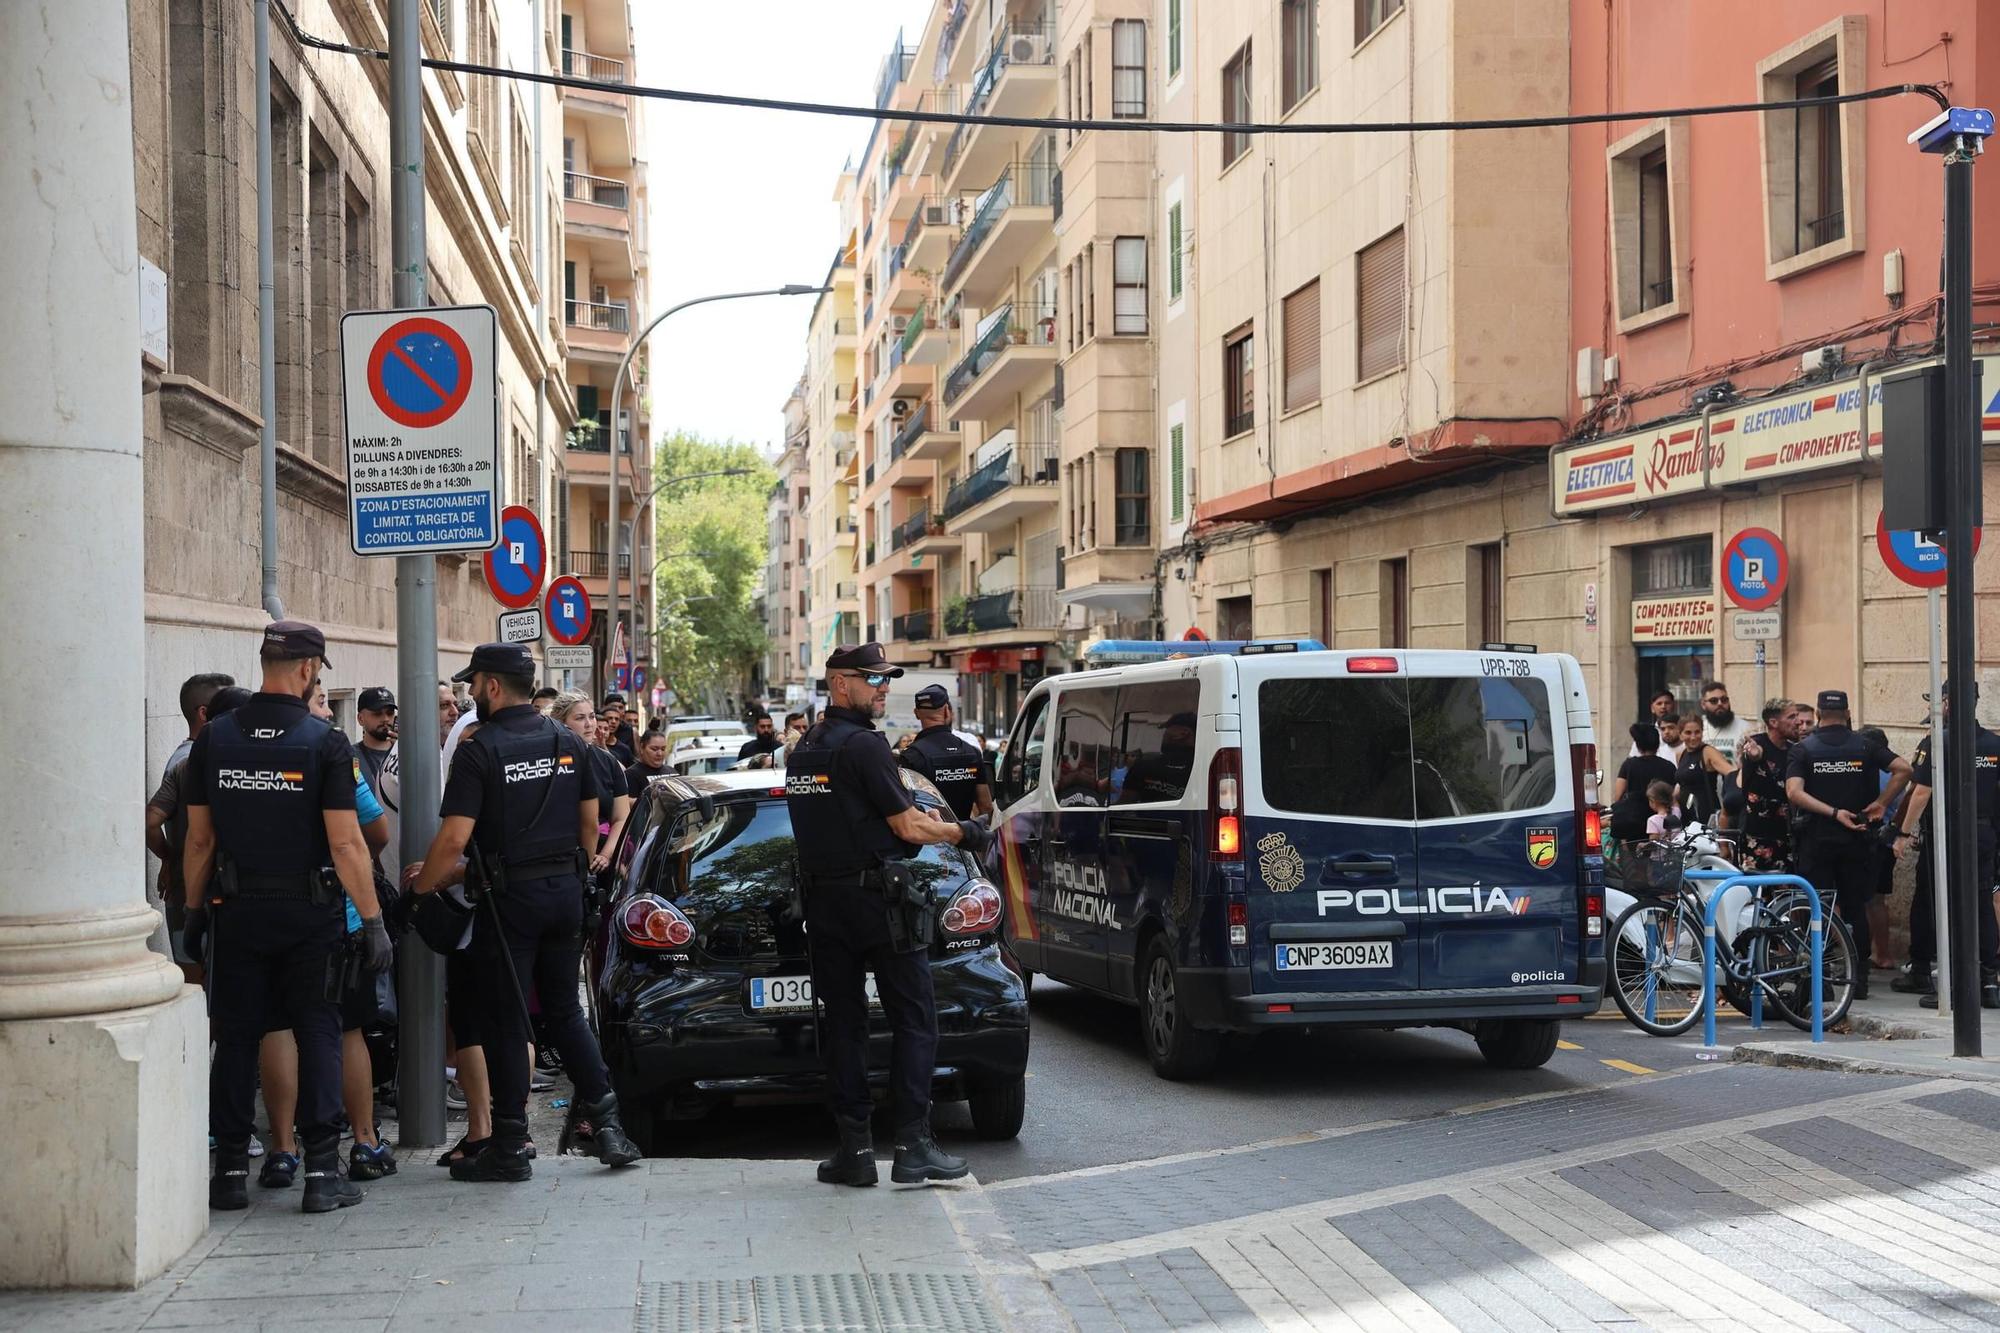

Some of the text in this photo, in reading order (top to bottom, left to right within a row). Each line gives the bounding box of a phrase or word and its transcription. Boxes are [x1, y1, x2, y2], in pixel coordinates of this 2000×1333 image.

[1743, 401, 1812, 434] ELECTRONICA
[353, 436, 402, 448] MÀXIM: 2h
[1779, 430, 1862, 464] COMPONENTES
[354, 448, 462, 463] DILLUNS A DIVENDRES:
[354, 460, 491, 478] de 9h a 14:30h i de 16:30h a 20h
[1566, 458, 1634, 492] ELECTRICA
[355, 477, 472, 493] DISSABTES de 9h a 14:30h
[360, 494, 487, 513] ZONA D'ESTACIONAMENT
[373, 512, 476, 528] LIMITAT. TARGETA DE
[365, 525, 485, 544] CONTROL OBLIGATÒRIA
[515, 545, 521, 560] P
[1749, 562, 1759, 578] P
[1740, 581, 1766, 590] MOTOS
[566, 605, 571, 614] P
[1636, 601, 1706, 619] COMPONENTES
[506, 615, 535, 628] VEHICLES
[1654, 620, 1714, 636] ELECTRONIC
[508, 628, 535, 641] OFICIALS
[1480, 658, 1531, 676] UPR-78B
[219, 770, 285, 780] POLICIA
[786, 775, 818, 784] POLICIA
[935, 774, 976, 782] NACIONAL
[219, 780, 303, 791] NACIONAL
[786, 784, 832, 794] NACIONAL
[1316, 880, 1514, 916] POLICÍA
[1053, 889, 1122, 930] NACIONAL
[946, 939, 981, 949] AYGO
[658, 954, 689, 962] TOYOTA
[1511, 970, 1565, 983] @policia
